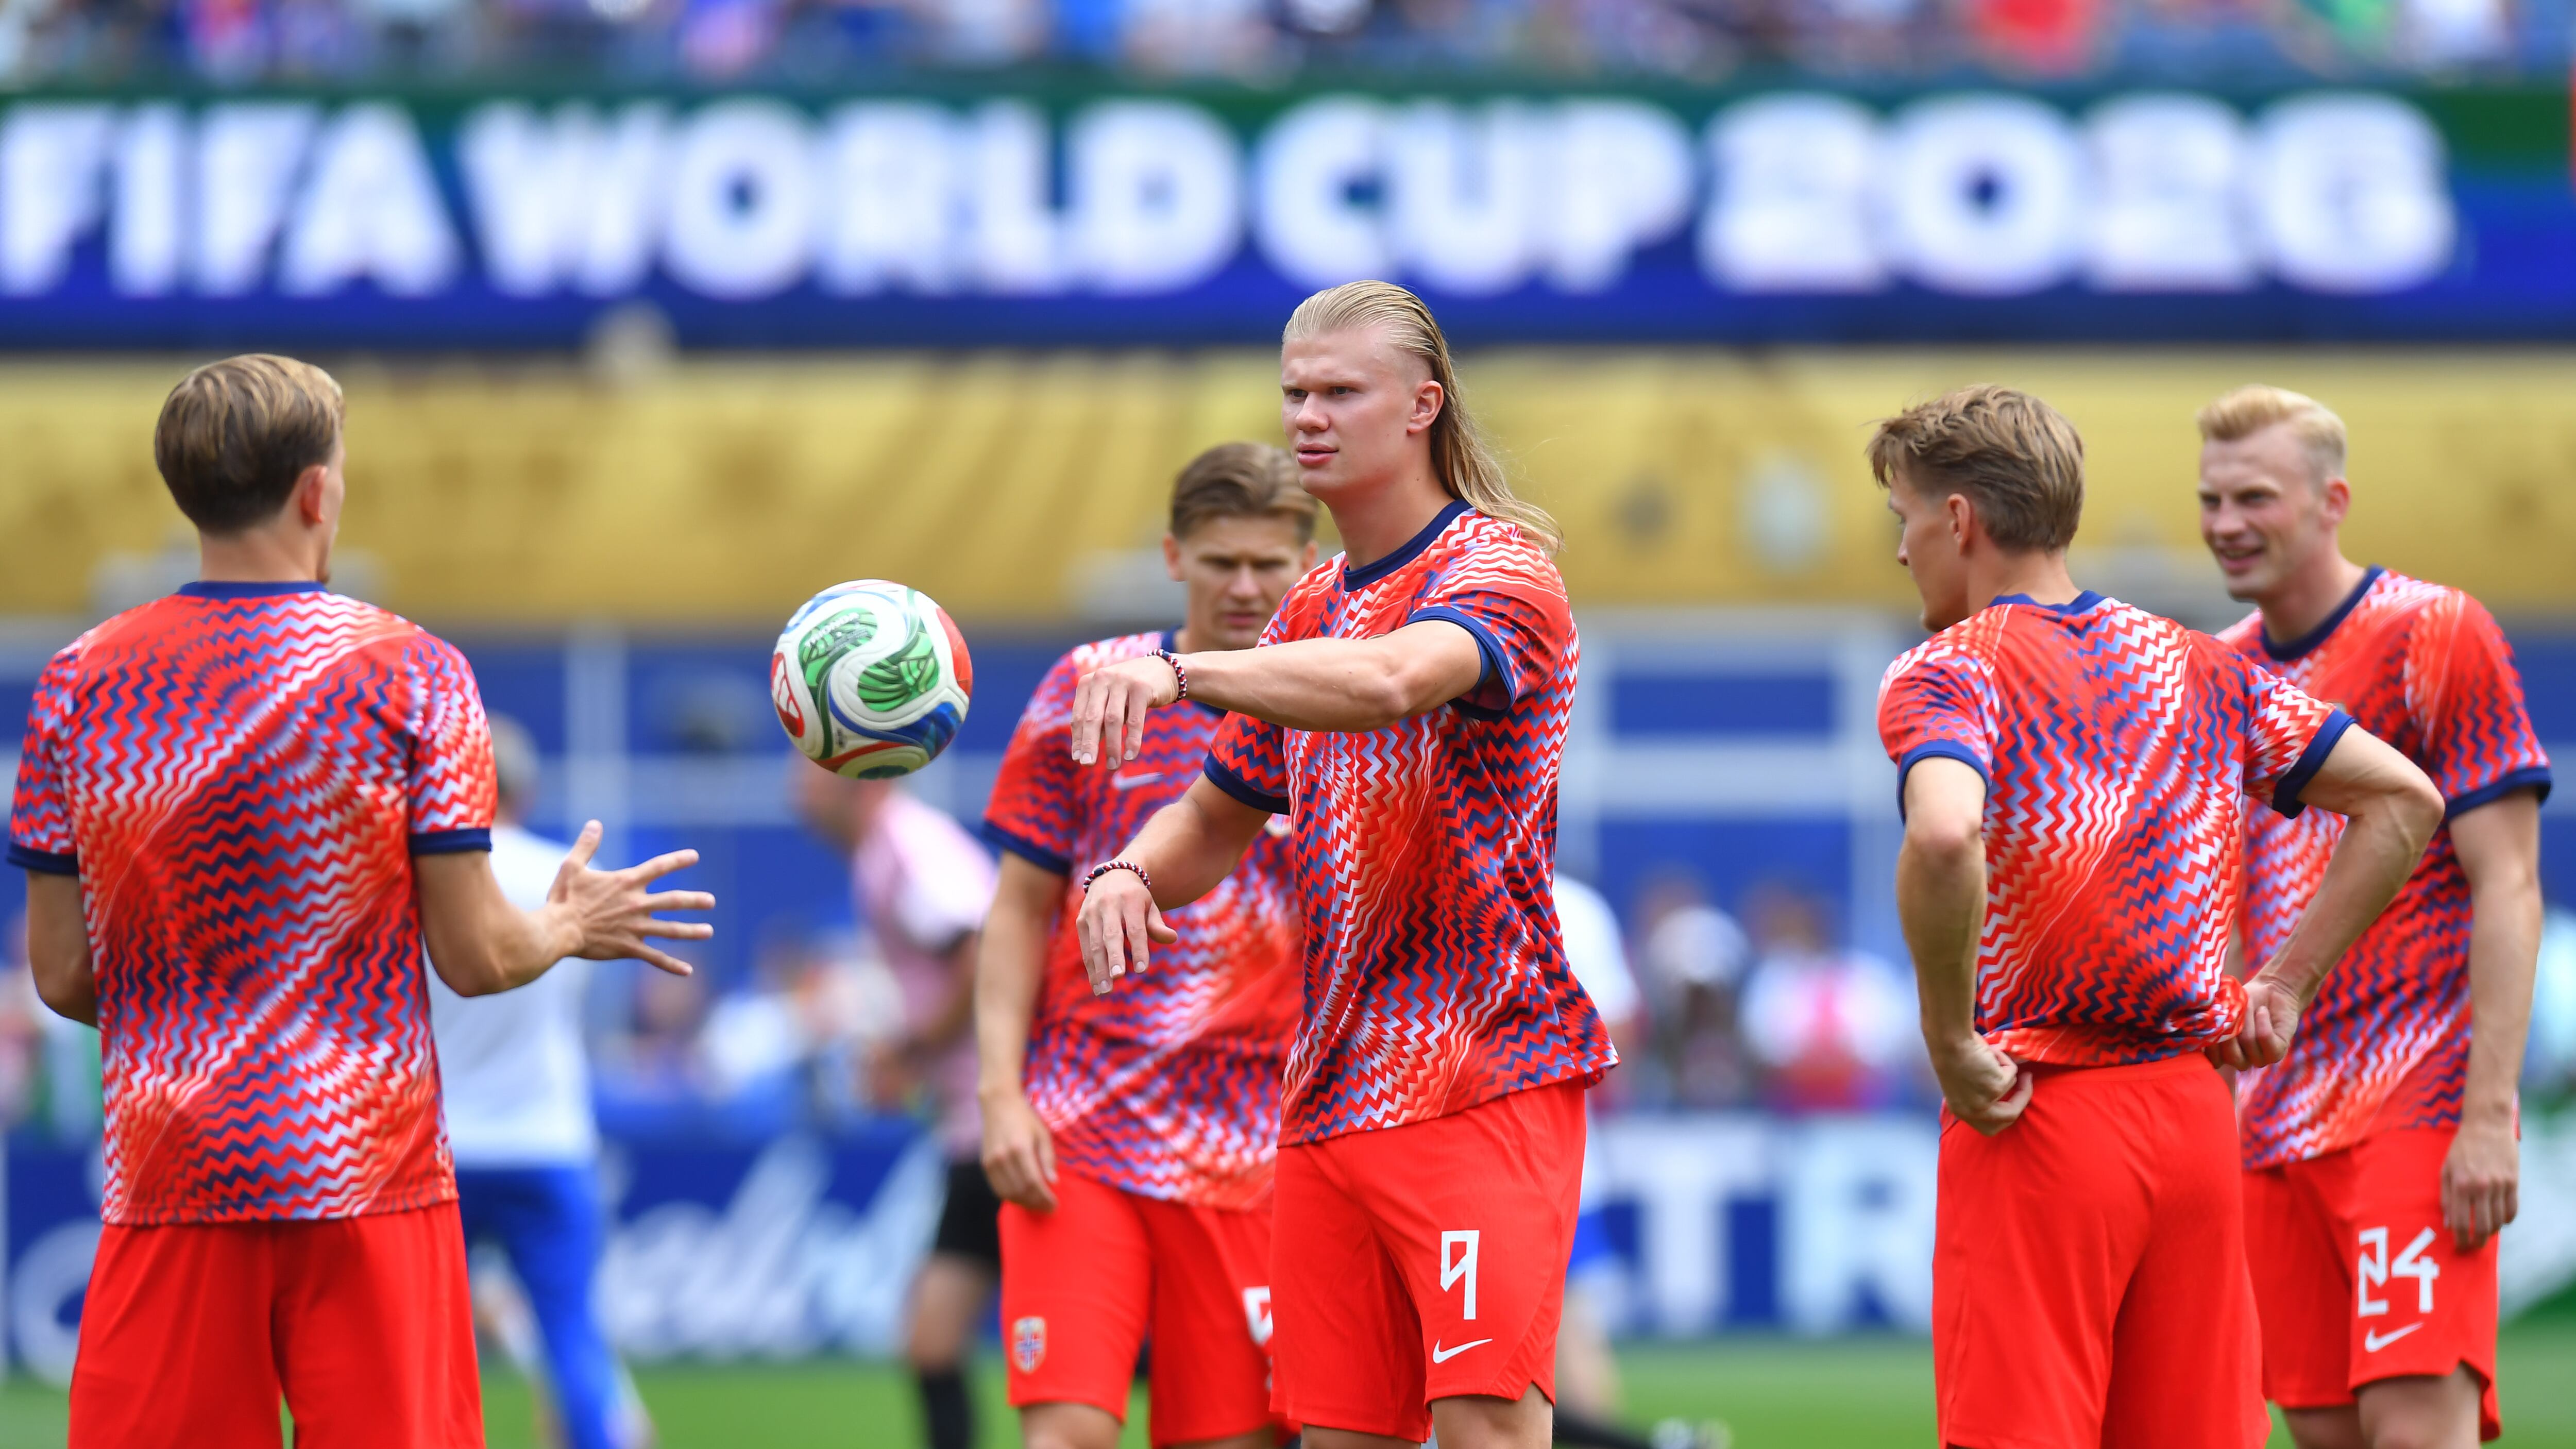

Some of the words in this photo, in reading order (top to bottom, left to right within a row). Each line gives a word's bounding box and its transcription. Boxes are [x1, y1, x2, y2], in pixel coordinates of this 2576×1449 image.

[1, 101, 460, 298] FIFA
[460, 101, 1240, 298] WORLD
[1254, 97, 1692, 294] CUP
[1701, 94, 2454, 294] 2026
[1440, 1229, 1480, 1320] 9
[2358, 1226, 2440, 1318] 24
